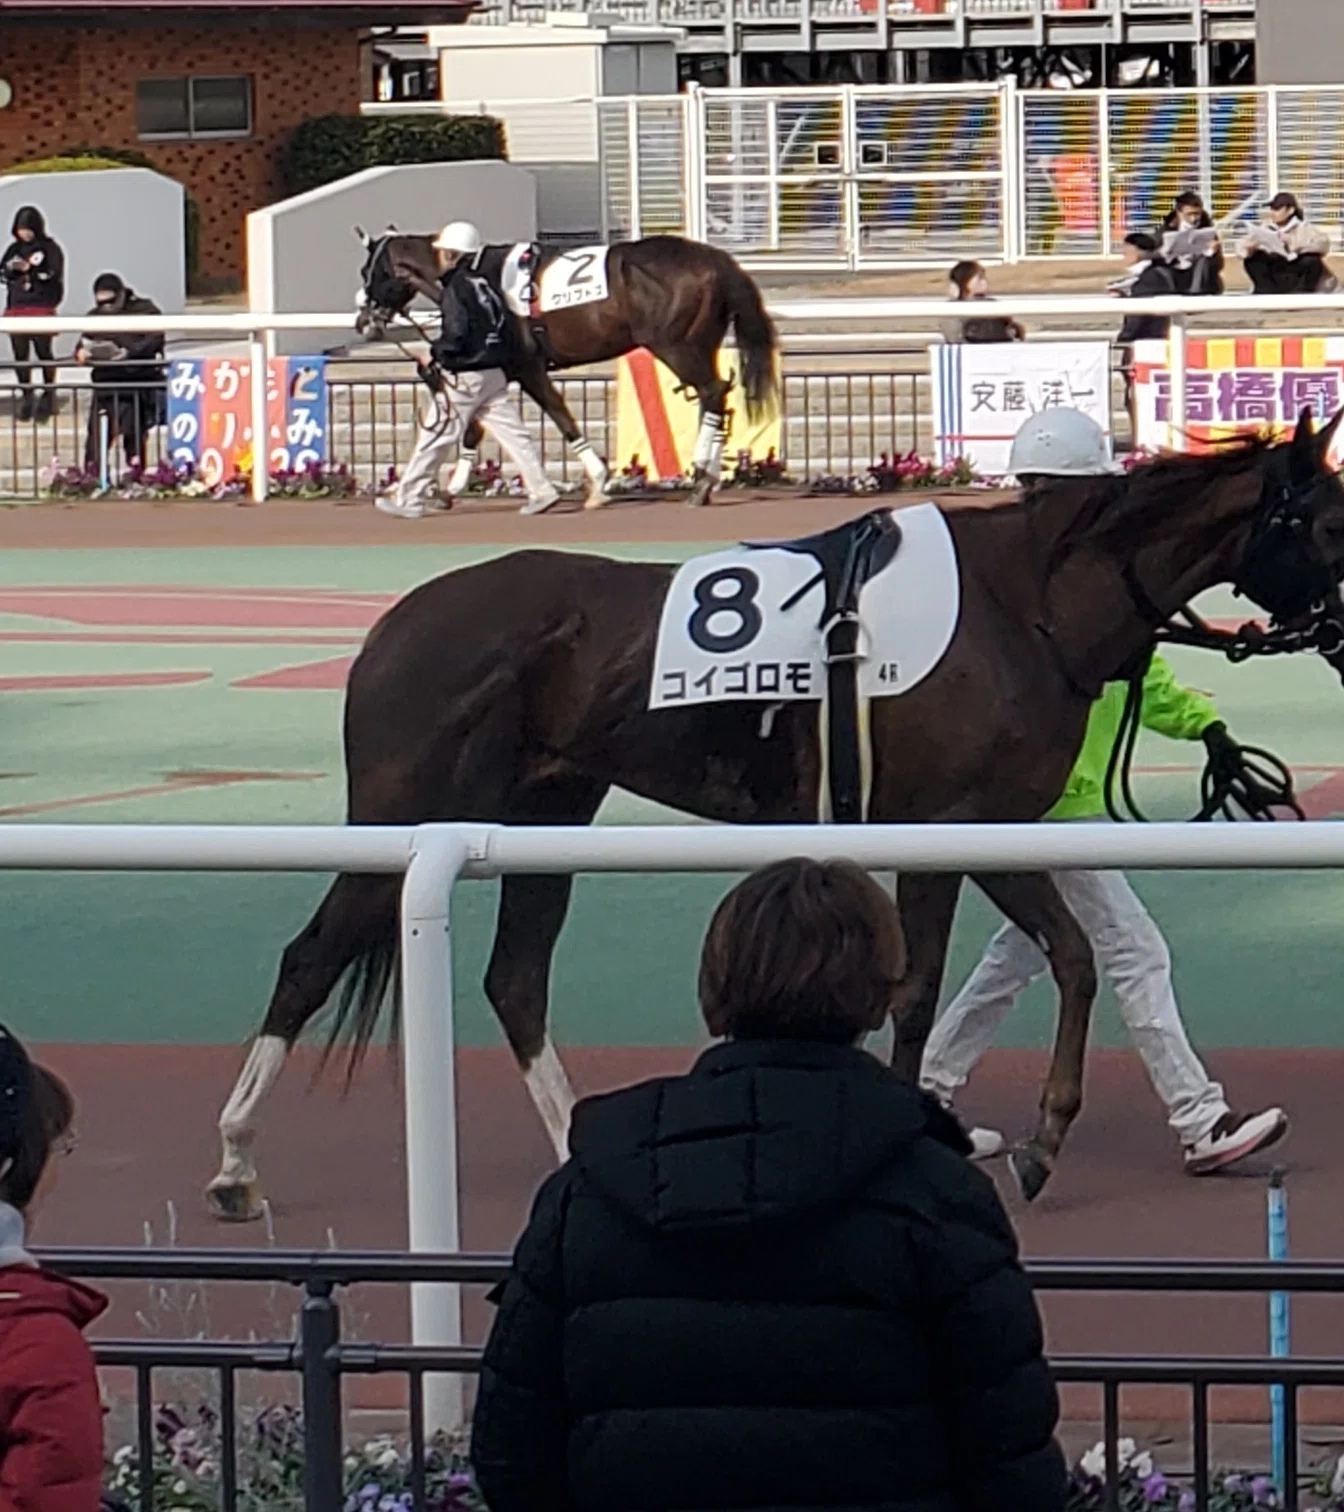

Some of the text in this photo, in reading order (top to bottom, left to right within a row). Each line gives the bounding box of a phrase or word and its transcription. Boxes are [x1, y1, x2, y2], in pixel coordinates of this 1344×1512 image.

[560, 253, 597, 286] 2
[688, 565, 761, 653] 8
[662, 661, 812, 701] コイゴロモ
[878, 662, 899, 685] 4R
